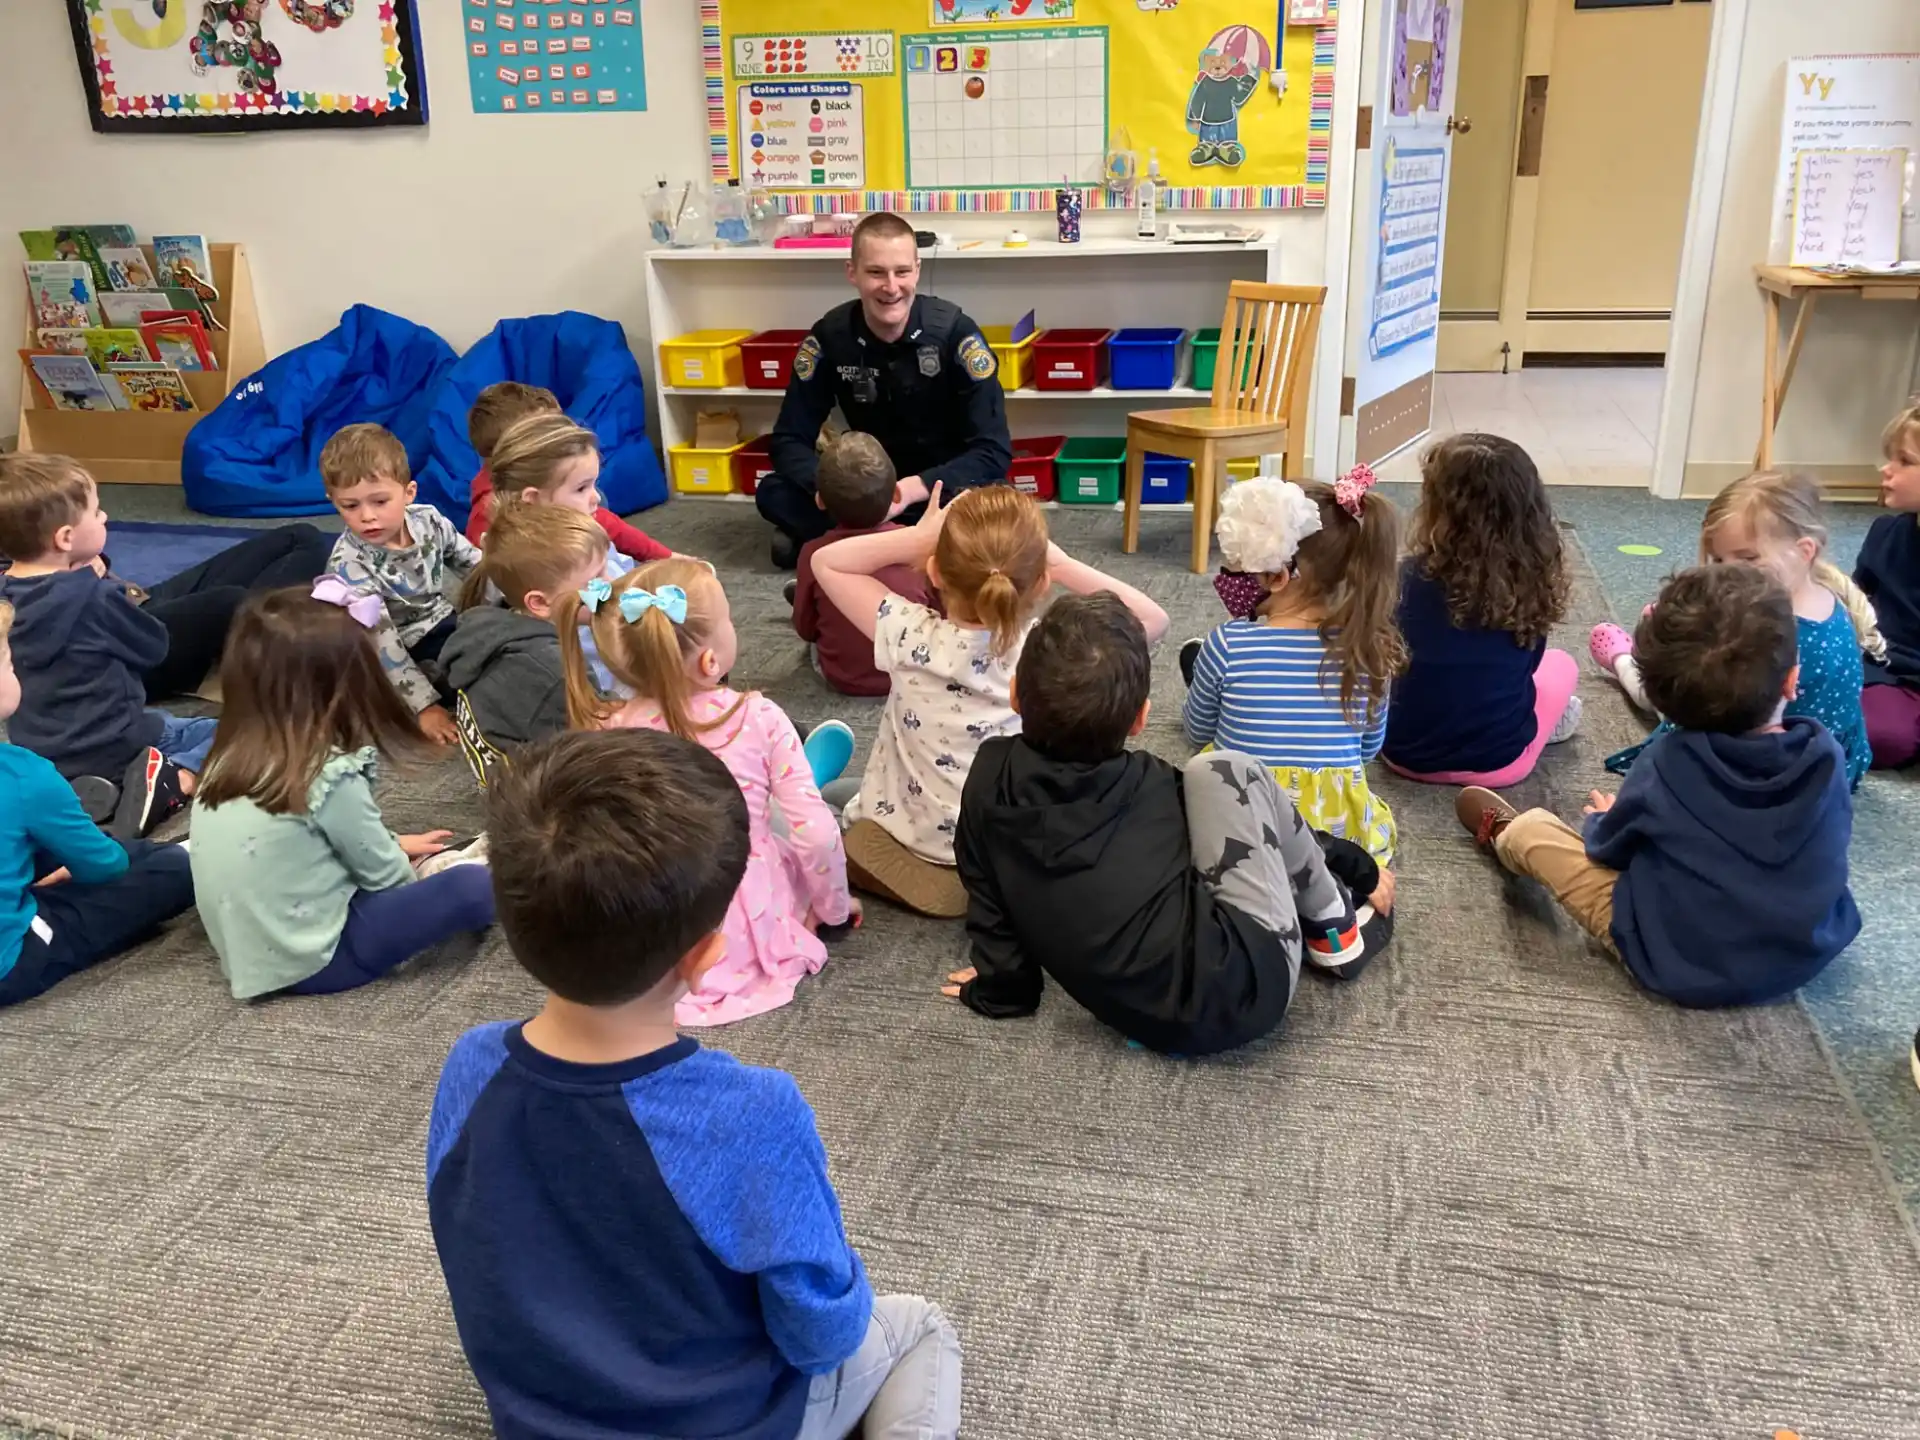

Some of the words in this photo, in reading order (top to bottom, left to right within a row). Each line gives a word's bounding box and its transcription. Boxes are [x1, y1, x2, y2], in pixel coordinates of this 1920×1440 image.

[743, 41, 754, 61] 9
[865, 37, 890, 57] 10
[915, 49, 923, 68] 1
[940, 49, 956, 69] 2
[971, 48, 986, 68] 3
[737, 63, 763, 74] NINE
[866, 59, 889, 71] TEN
[753, 85, 787, 94] Colors
[788, 84, 808, 93] and
[810, 82, 849, 93] Shapes
[1799, 73, 1835, 101] Yy
[766, 102, 782, 111] red
[825, 100, 852, 110] black
[766, 119, 796, 131] yellow
[827, 118, 847, 129] pink
[767, 136, 787, 145] blue
[828, 135, 849, 146] gray
[767, 153, 800, 164] orange
[828, 152, 858, 162] brown
[767, 170, 798, 181] purple
[828, 169, 857, 181] green
[837, 366, 880, 376] SCITTE
